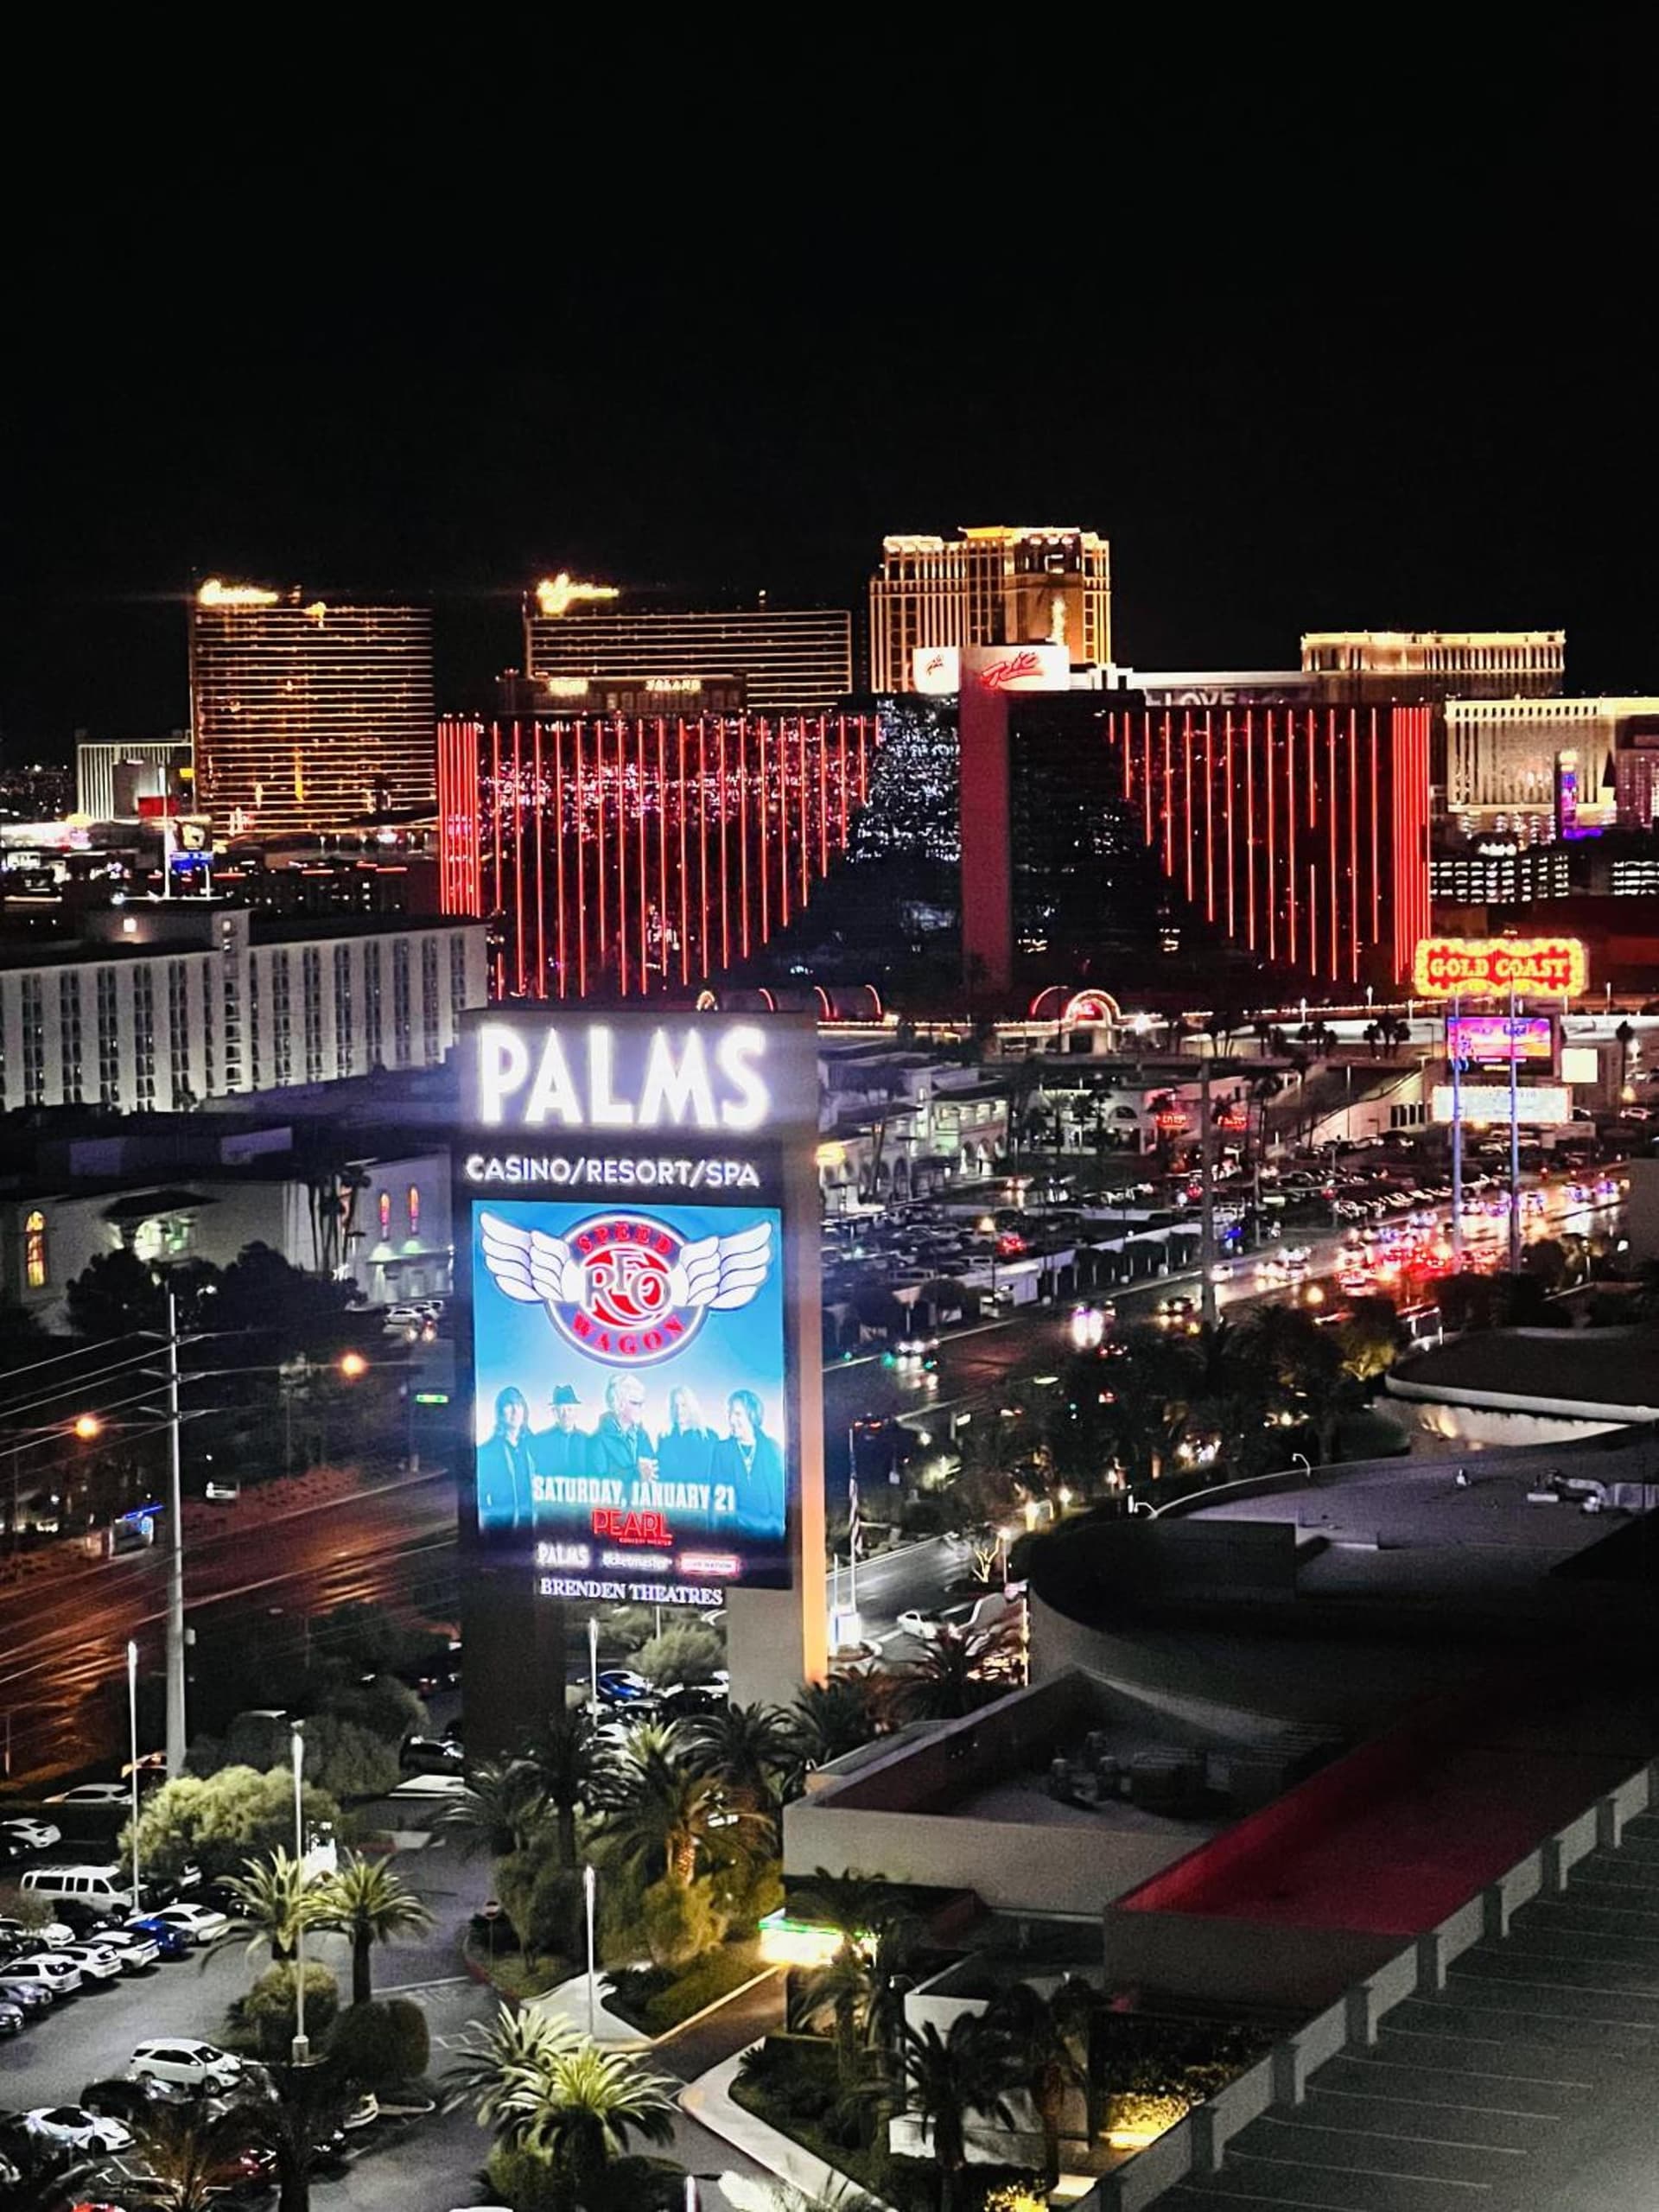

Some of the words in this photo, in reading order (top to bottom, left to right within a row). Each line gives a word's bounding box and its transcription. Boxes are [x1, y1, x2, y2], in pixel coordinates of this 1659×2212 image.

[981, 651, 1044, 688] Rio
[1430, 958, 1489, 977] GOLD
[1495, 957, 1568, 977] COAST
[478, 1024, 772, 1130] PALMS
[577, 1221, 673, 1255] SPEED
[585, 1251, 671, 1321] REO
[573, 1310, 684, 1354] WAGON
[532, 1476, 627, 1507] SATURDAY,
[632, 1481, 710, 1510] JANUARY
[715, 1484, 735, 1511] 21
[592, 1509, 672, 1538] PEARL
[537, 1541, 589, 1568] PALMS
[540, 1577, 626, 1599] BRENDEN
[628, 1583, 723, 1605] THEATRES
